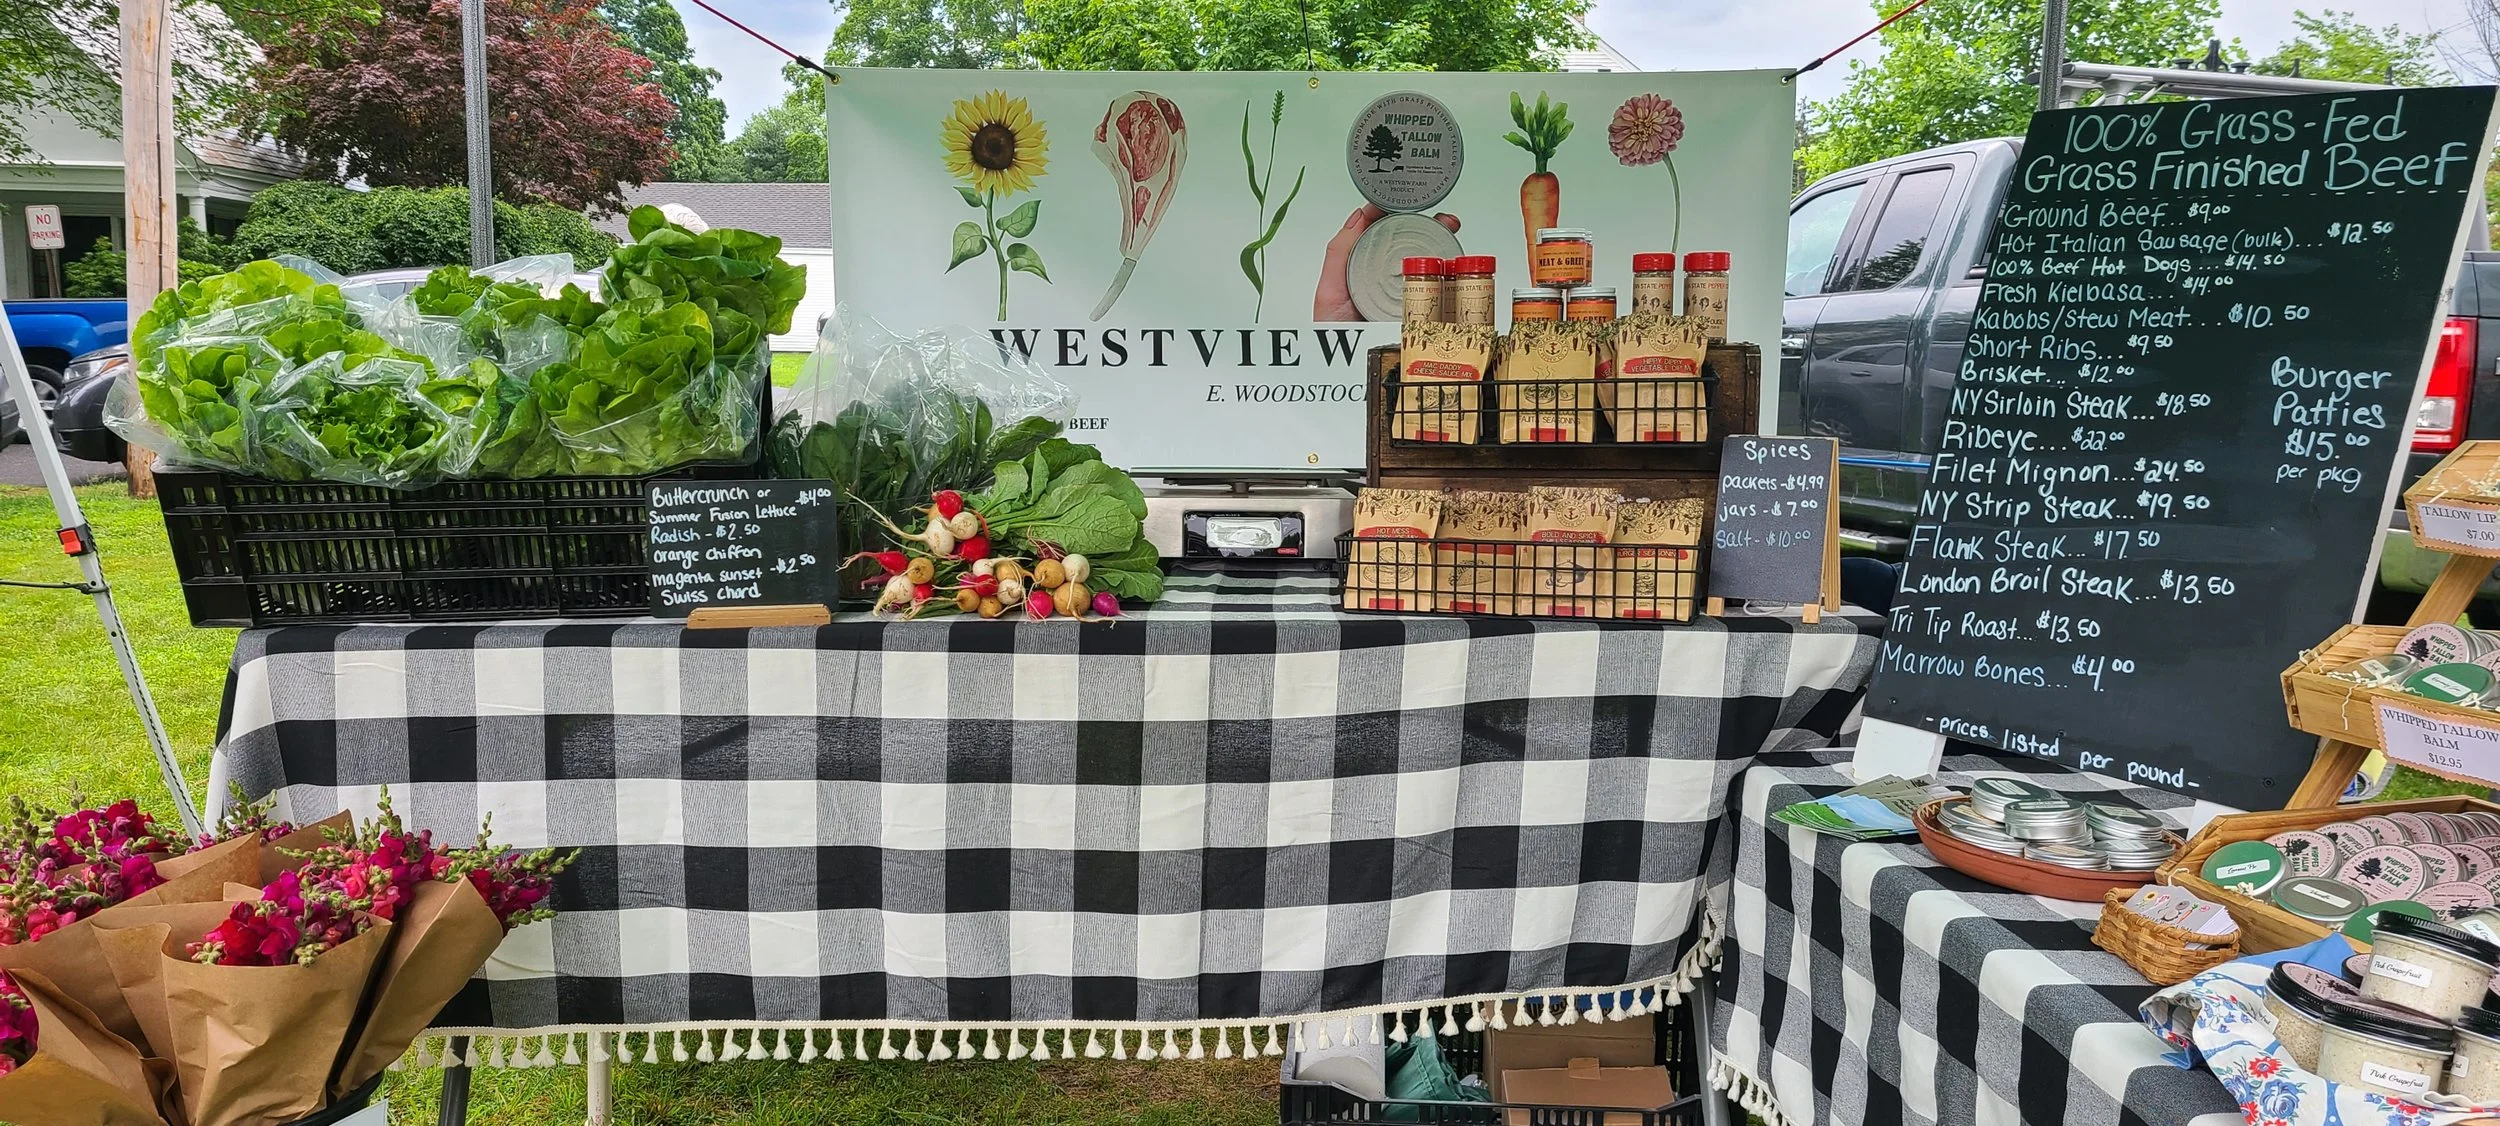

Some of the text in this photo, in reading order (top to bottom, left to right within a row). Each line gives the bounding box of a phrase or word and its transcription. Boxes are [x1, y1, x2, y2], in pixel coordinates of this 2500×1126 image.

[1385, 114, 1434, 126] WHIPPED
[2064, 107, 2162, 153] 100%
[1401, 132, 1442, 142] TALLOW
[1411, 148, 1439, 158] BALM
[2025, 142, 2467, 192] Grass Finished Beef
[36, 214, 51, 225] NO
[2005, 204, 2088, 227] Ground
[33, 231, 60, 239] PARKING
[1998, 233, 2035, 253] Hot
[2045, 233, 2124, 253] Italian
[2137, 229, 2228, 254] Sausage
[1990, 259, 2033, 277] 100%
[2042, 257, 2085, 275] Beef
[2091, 256, 2125, 275] Hot
[1984, 283, 2036, 302] Fresh
[988, 329, 1366, 367] WESTVIEW
[1969, 333, 2031, 358] Short
[2272, 356, 2391, 405] Burger
[1205, 385, 1225, 402] E.
[2274, 389, 2385, 428] Patties
[1069, 418, 1109, 429] BEEF
[1744, 440, 1811, 464] Spices
[1932, 453, 1996, 484] Filet
[2276, 464, 2361, 493] per pkg
[1723, 475, 1777, 493] packets
[652, 487, 749, 507] Buttercrunch
[757, 489, 771, 497] or
[649, 504, 797, 524] Summer Fusion Lettuce
[1719, 502, 1756, 522] jars
[1921, 490, 1958, 519] NY
[1966, 492, 2030, 527] Strip
[2421, 505, 2497, 524] TALLOW LIP
[651, 526, 700, 544] Radish
[1716, 529, 1752, 548] Salt
[1909, 525, 1984, 560] Flank
[2466, 529, 2495, 541] $7.00
[652, 572, 714, 590] magenta
[720, 568, 762, 582] sunset
[1900, 562, 1980, 594] London
[1992, 563, 2051, 595] Broil
[661, 590, 708, 605] Swiss
[1890, 605, 1913, 632] Tri
[1924, 607, 1951, 643] Tip
[2429, 635, 2457, 651] WHIPPED
[2431, 645, 2455, 660] TALLOW
[1880, 640, 1964, 676] Marrow
[2383, 708, 2500, 743] WHIPPED TALLOW
[2003, 729, 2060, 757] listed
[2080, 751, 2114, 769] per
[2423, 734, 2460, 750] BALM
[2428, 752, 2463, 769] $12.95
[2341, 832, 2364, 849] WHIPPED
[2384, 856, 2412, 872] WHIPPED
[2384, 866, 2410, 881] TALLOW
[2381, 874, 2402, 887] BALM
[2374, 961, 2422, 980] Pink Grapefruit
[2369, 1069, 2424, 1089] Pink Grapefruit
